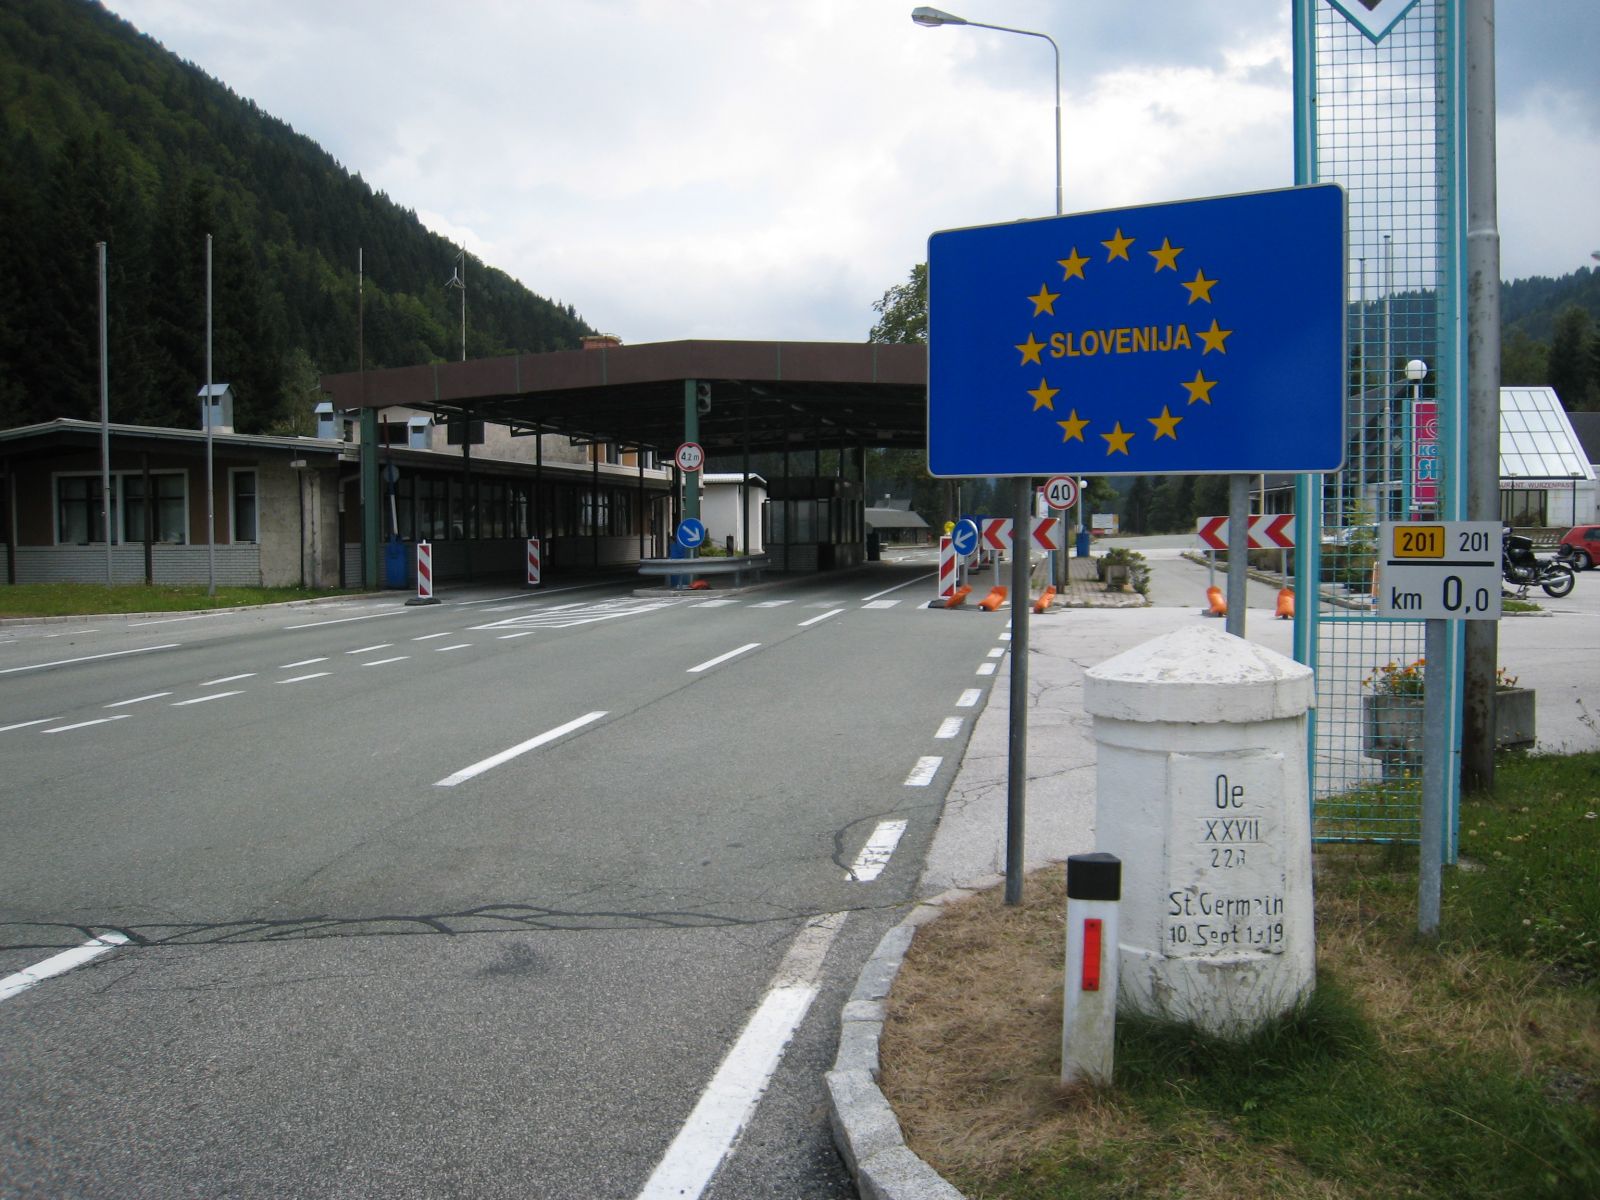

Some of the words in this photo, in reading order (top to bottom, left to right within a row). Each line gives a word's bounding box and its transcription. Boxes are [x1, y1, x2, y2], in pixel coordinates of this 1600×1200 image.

[1050, 324, 1192, 358] SLOVENIJA
[1050, 484, 1071, 501] 40
[1402, 532, 1435, 552] 201
[1459, 532, 1489, 552] 201
[1391, 586, 1422, 610] km
[1442, 575, 1489, 614] 0,0
[1205, 819, 1259, 841] XXVII
